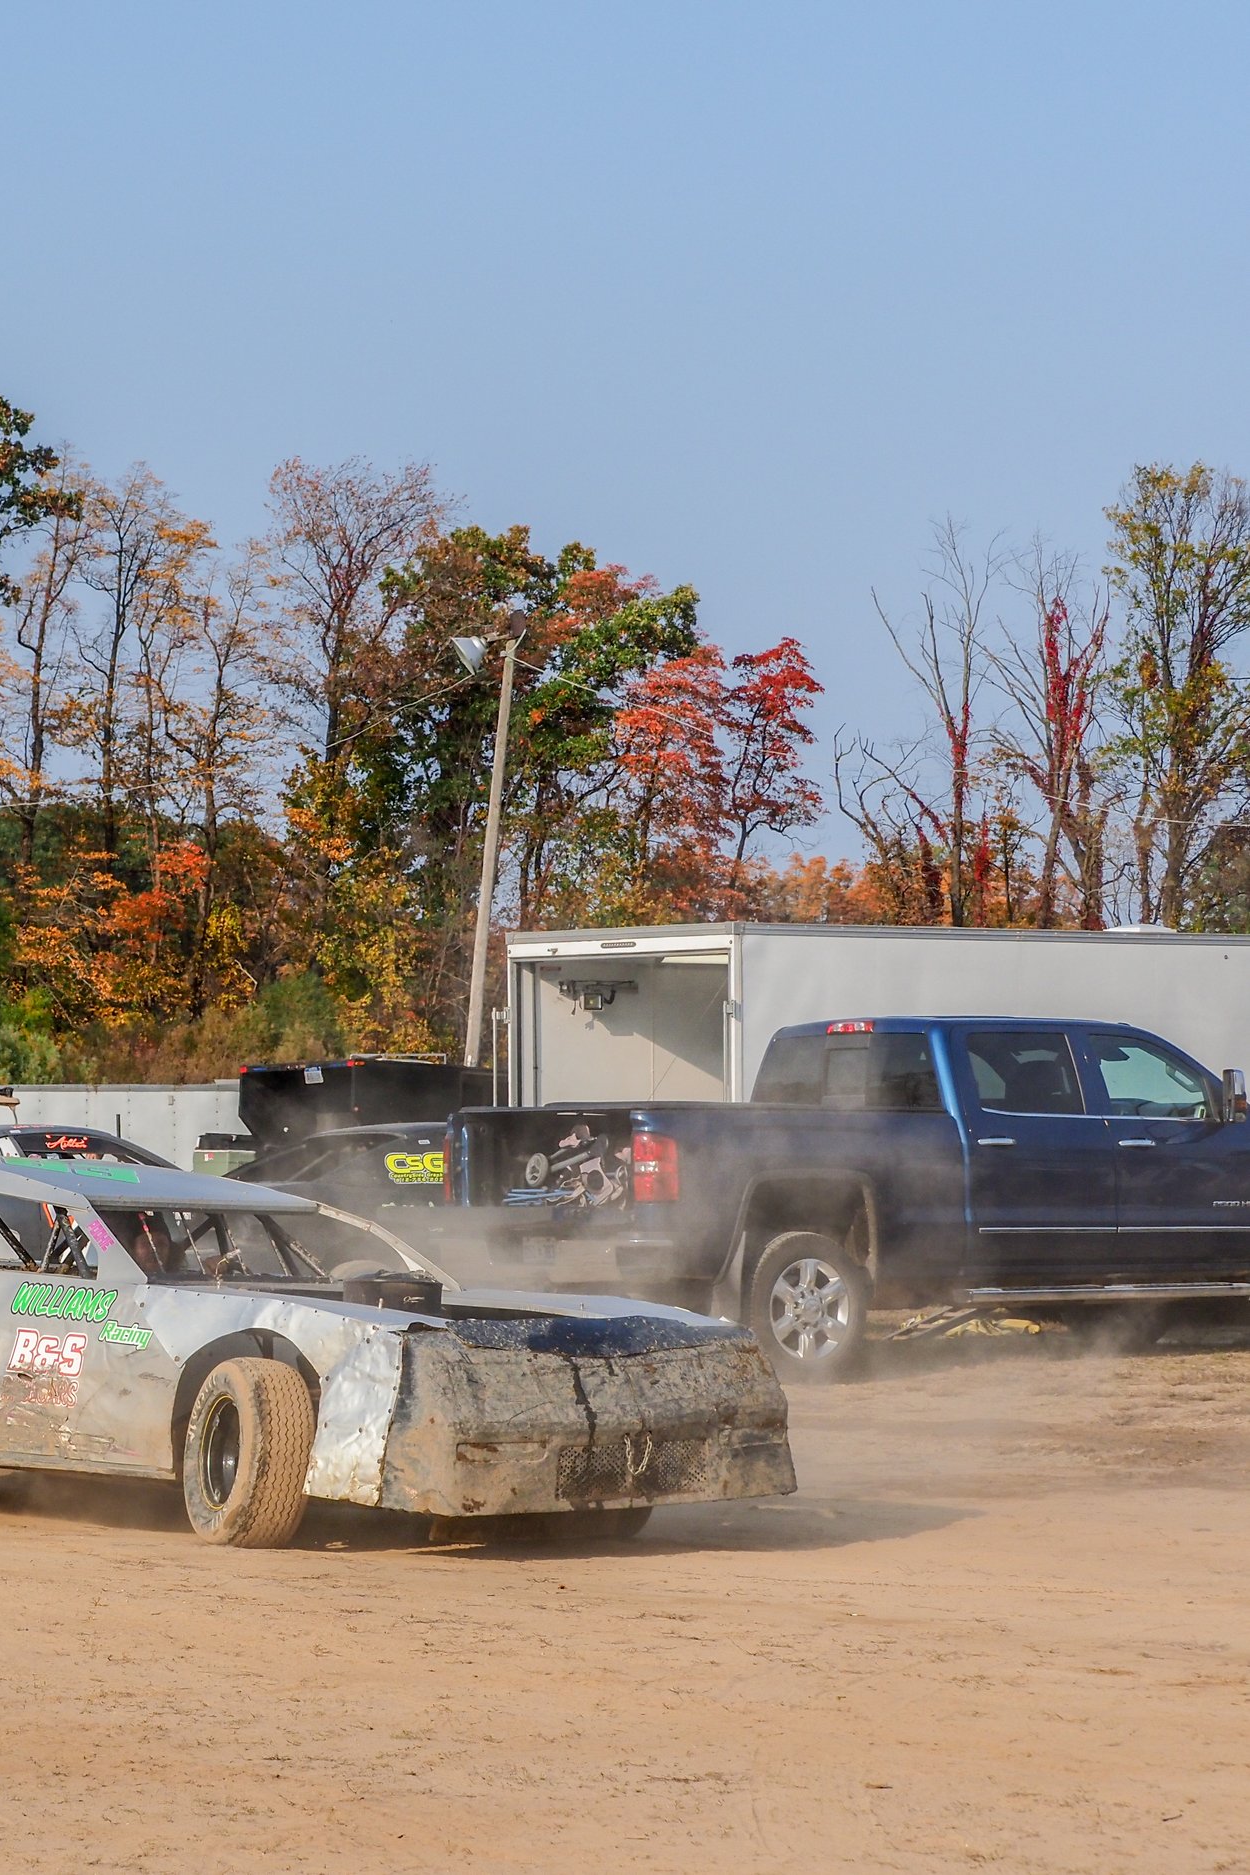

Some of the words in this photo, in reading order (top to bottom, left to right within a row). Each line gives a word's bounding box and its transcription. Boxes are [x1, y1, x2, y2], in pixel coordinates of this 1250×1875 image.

[11, 1281, 118, 1323] WILLIAMS
[6, 1327, 88, 1377] B&S
[98, 1319, 153, 1351] Racing
